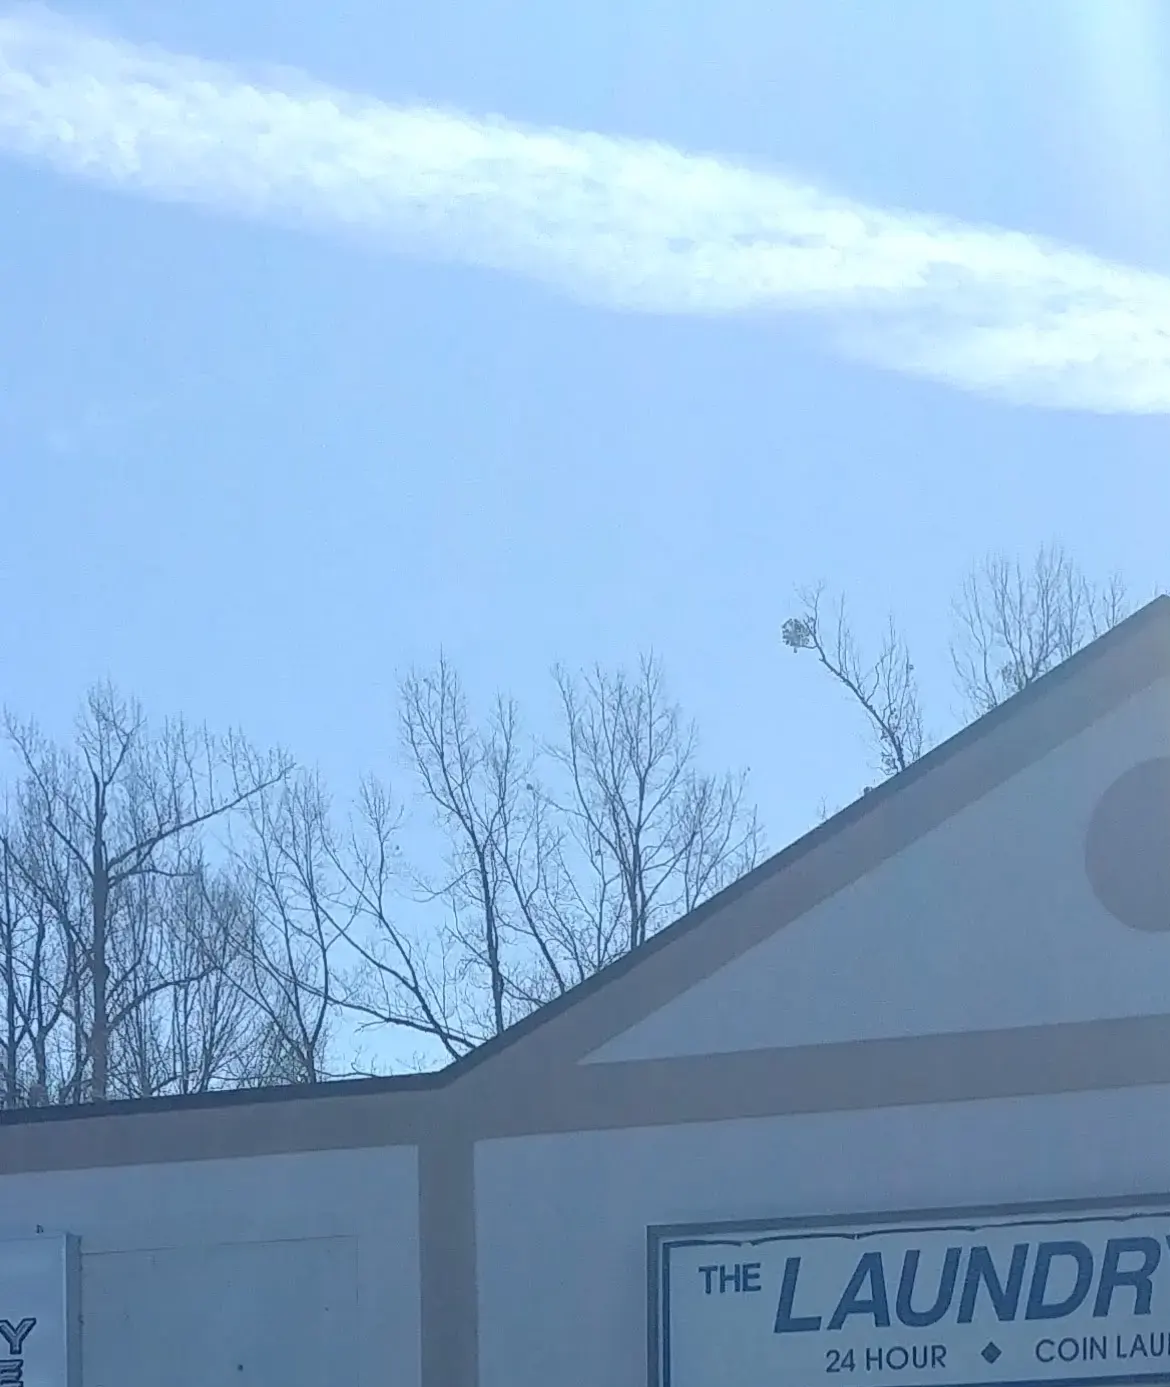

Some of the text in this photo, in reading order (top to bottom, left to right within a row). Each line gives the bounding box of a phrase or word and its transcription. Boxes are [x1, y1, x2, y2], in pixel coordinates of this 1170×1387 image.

[698, 1262, 762, 1295] THE
[825, 1344, 947, 1373] 24 HOUR
[1035, 1335, 1107, 1363] COIN
